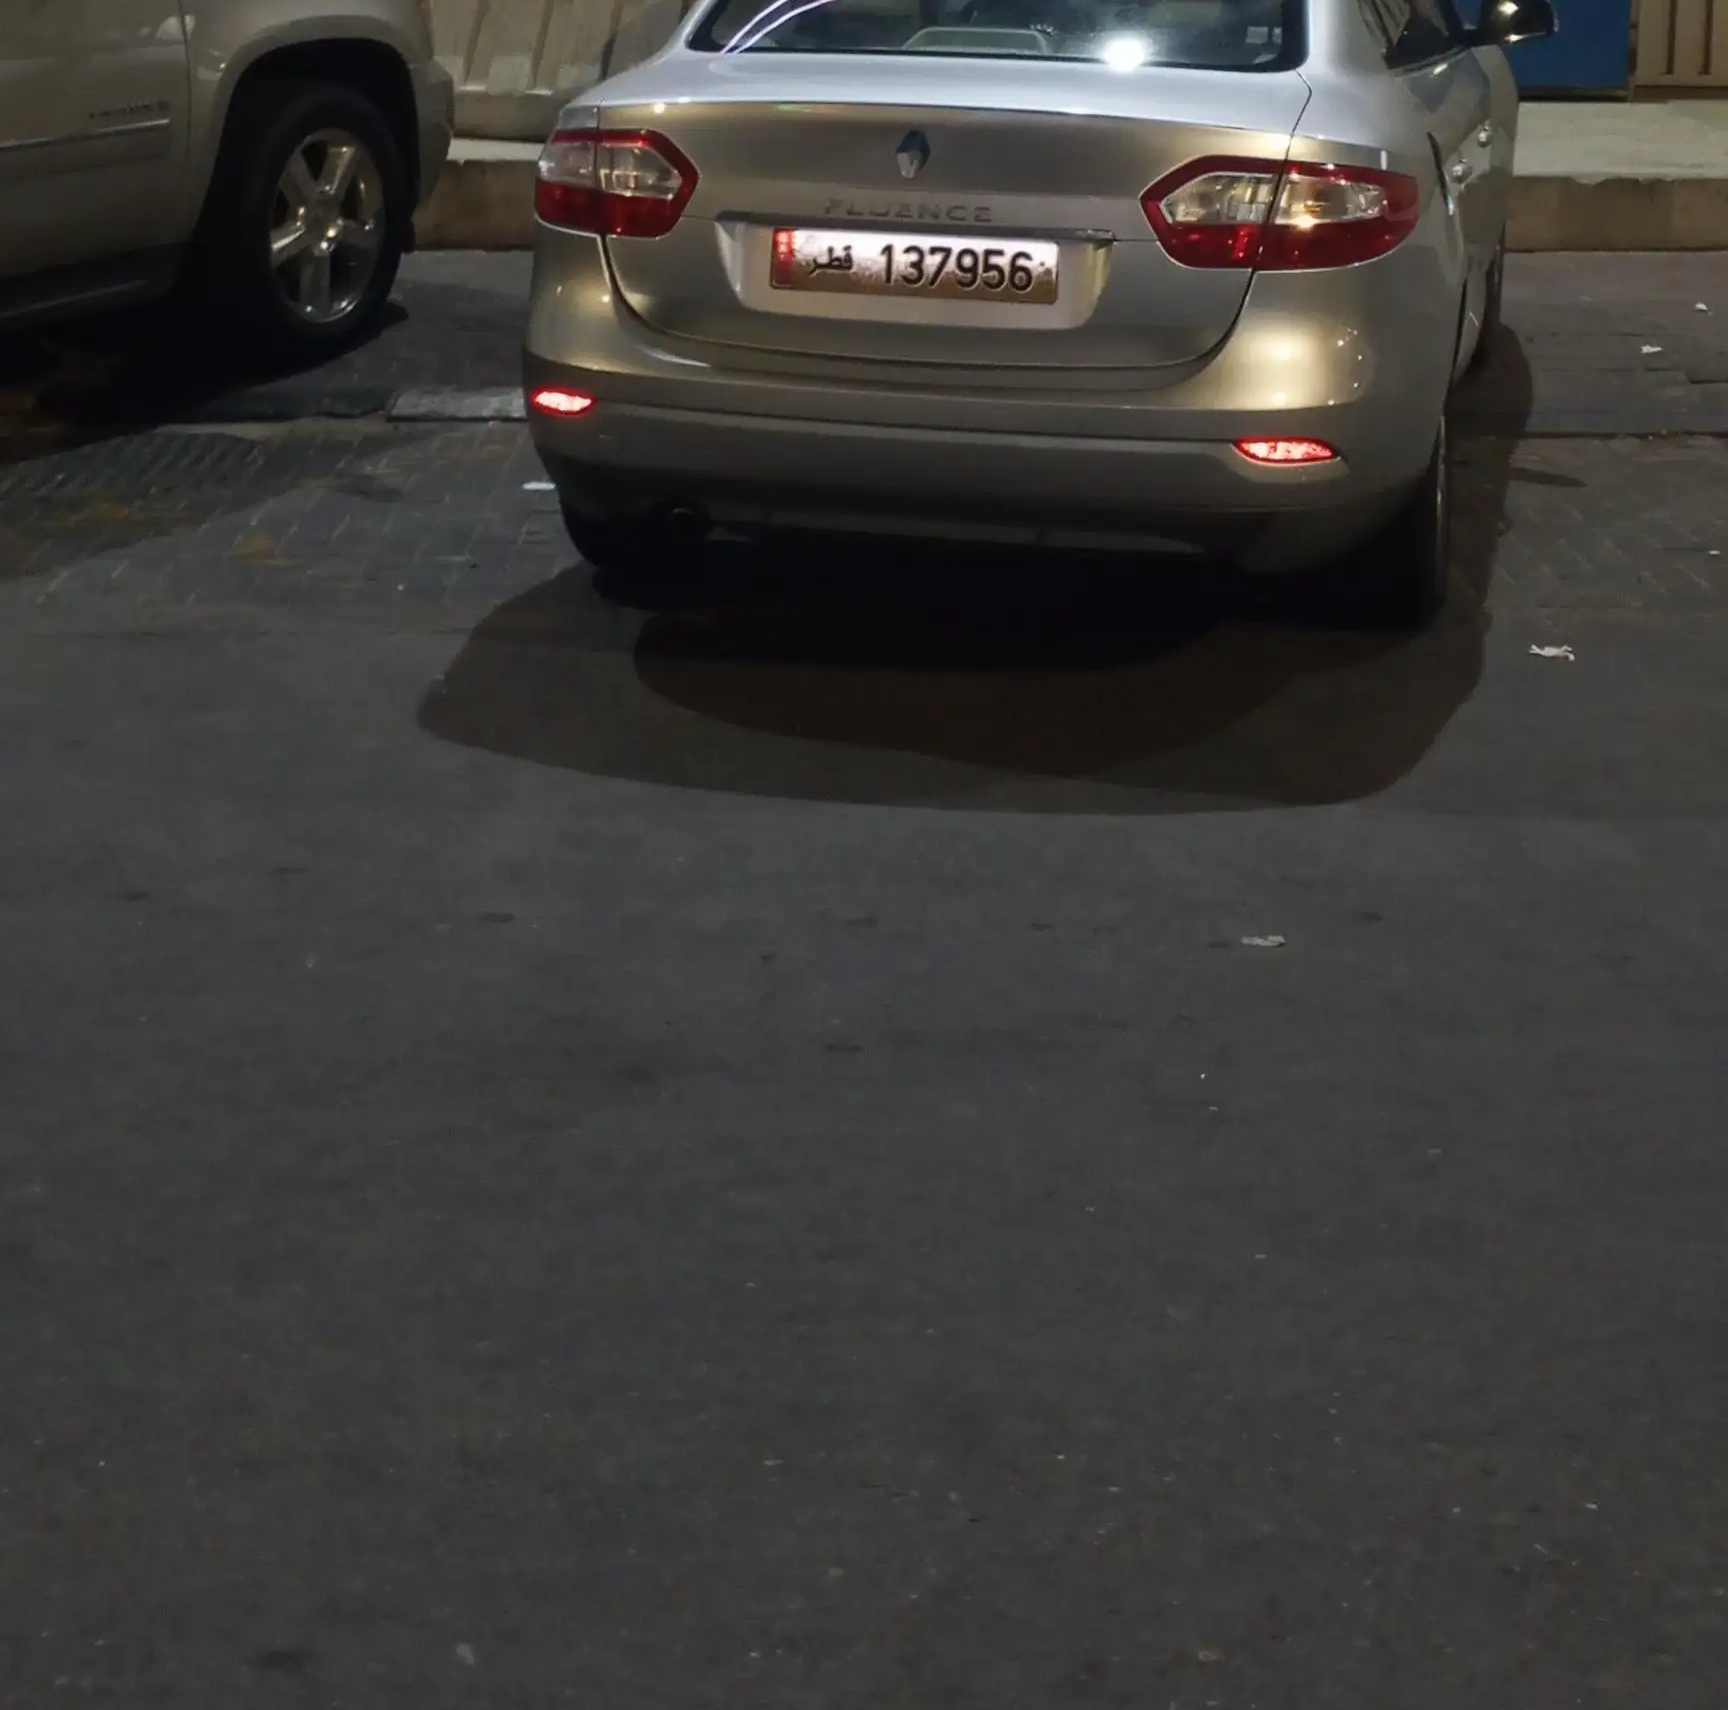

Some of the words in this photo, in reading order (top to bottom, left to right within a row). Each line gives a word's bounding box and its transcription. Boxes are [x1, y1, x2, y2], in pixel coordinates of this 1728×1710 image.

[824, 197, 992, 223] FLUENCE
[808, 244, 854, 276] قطر
[880, 243, 1034, 292] 137956
